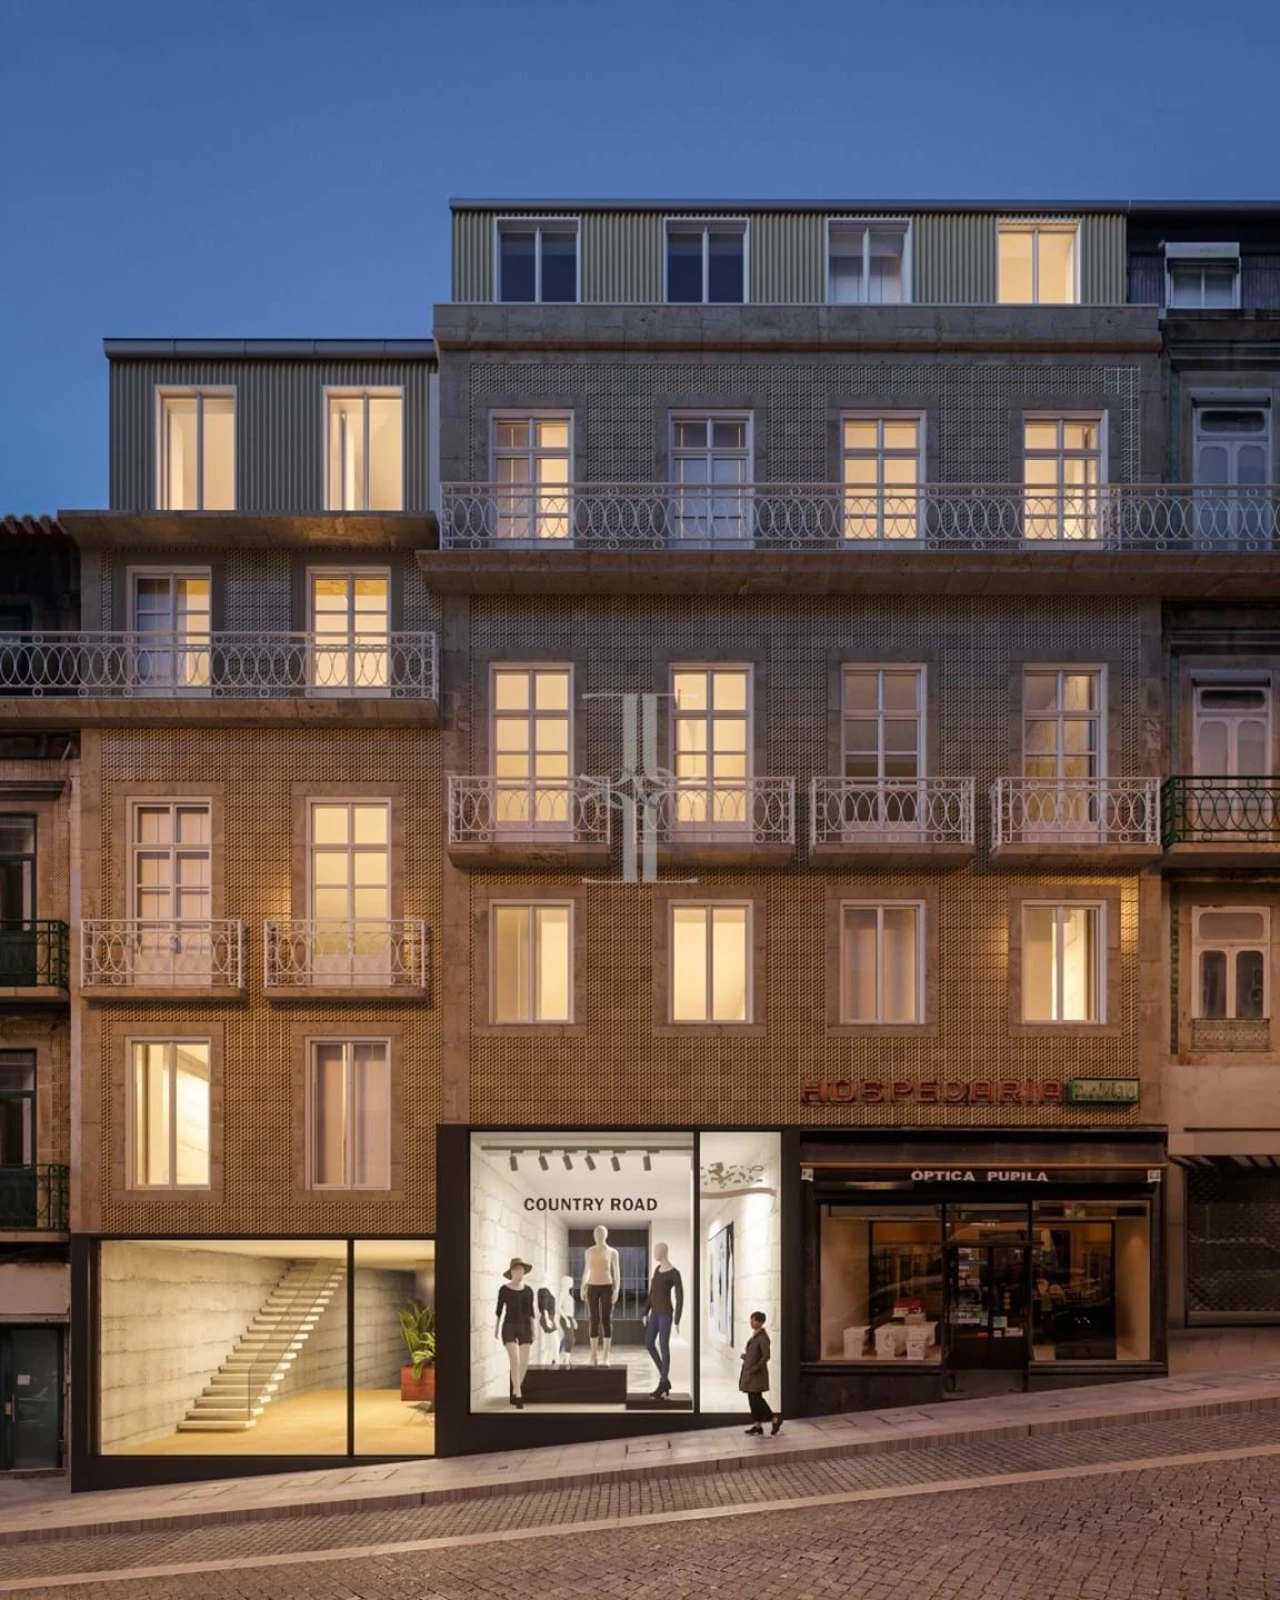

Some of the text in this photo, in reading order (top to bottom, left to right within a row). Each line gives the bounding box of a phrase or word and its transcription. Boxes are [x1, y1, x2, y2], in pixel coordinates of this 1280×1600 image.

[799, 1079, 1063, 1103] HOSPEDARIA
[986, 1170, 1049, 1182] PUPILA
[523, 1197, 658, 1211] COUNTRY ROAD
